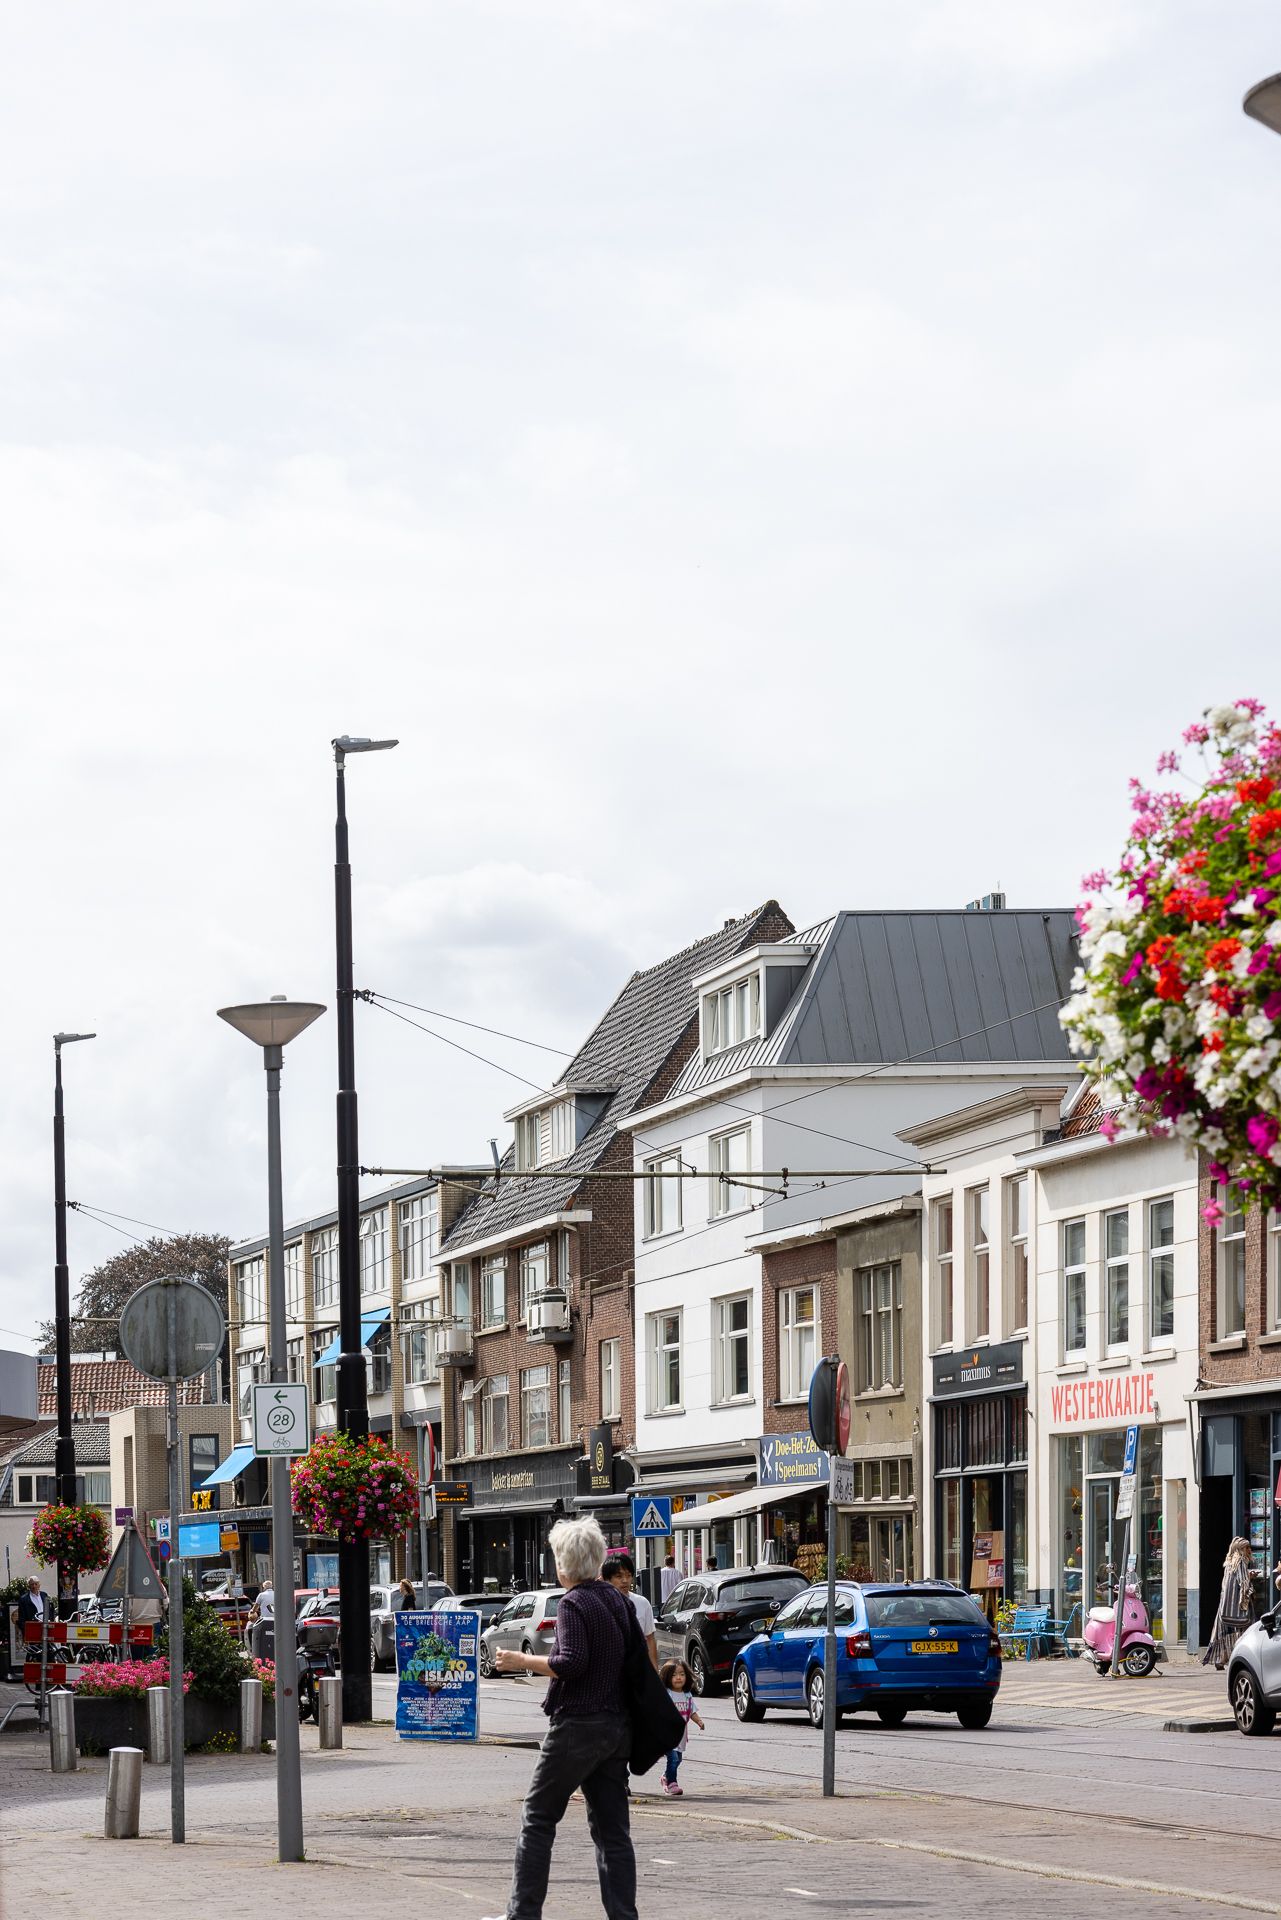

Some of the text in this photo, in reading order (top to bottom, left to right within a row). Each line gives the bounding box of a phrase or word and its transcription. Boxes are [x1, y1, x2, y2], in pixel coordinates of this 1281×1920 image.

[960, 1365, 992, 1383] maximus
[1051, 1373, 1154, 1424] WESTERKAATJE
[272, 1414, 290, 1426] 28
[774, 1436, 820, 1457] Doe-Het-Zel
[778, 1459, 818, 1482] Speelmans
[914, 1642, 955, 1651] GJX-55-K
[406, 1659, 468, 1672] COME TO
[399, 1670, 475, 1682] MY ISLAND
[441, 1682, 463, 1690] 2025
